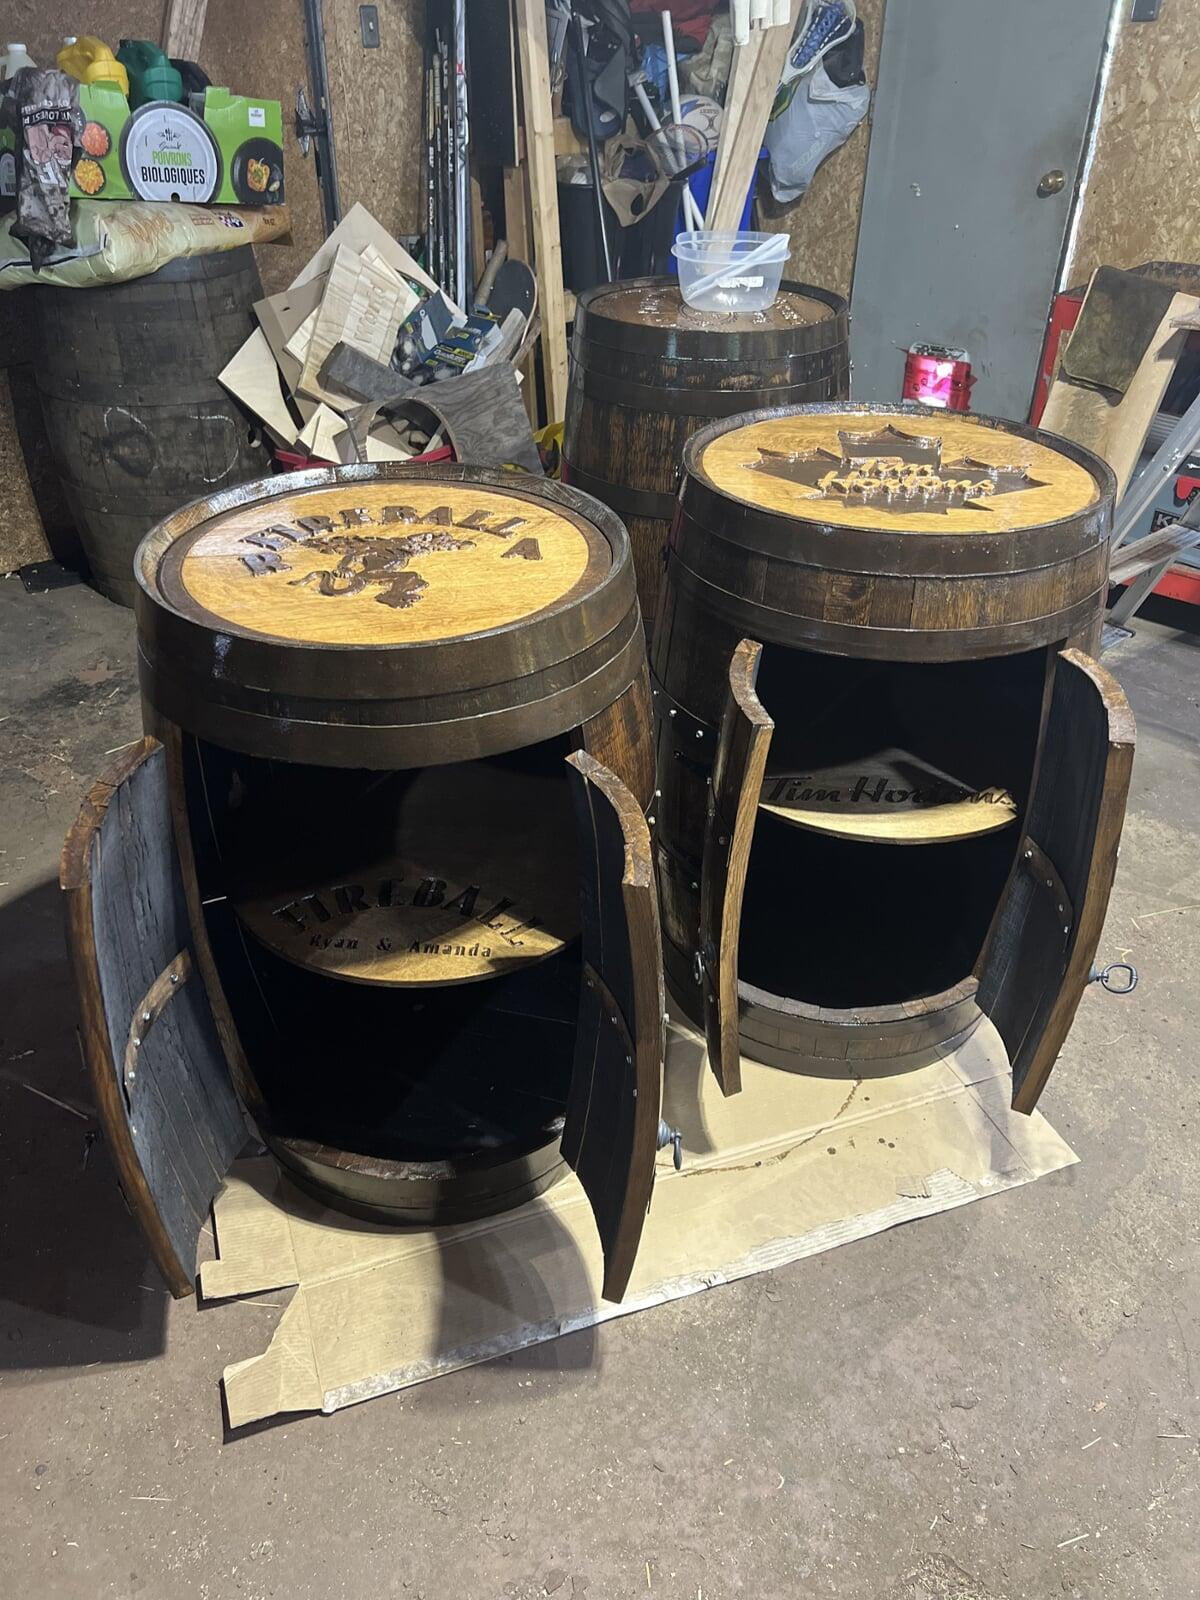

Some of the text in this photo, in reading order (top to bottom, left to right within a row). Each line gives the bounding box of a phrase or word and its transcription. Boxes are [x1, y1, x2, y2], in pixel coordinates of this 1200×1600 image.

[152, 150, 192, 167] POIVRONS
[141, 166, 205, 186] BIOLOGIQUES
[848, 456, 934, 481] Tim
[815, 471, 995, 498] Hortons
[240, 505, 531, 550] FIREBALL
[240, 537, 543, 577] R A
[763, 775, 840, 802] Tim
[272, 876, 546, 948] FIREBALL
[310, 934, 493, 958] Ryan & Amanda
